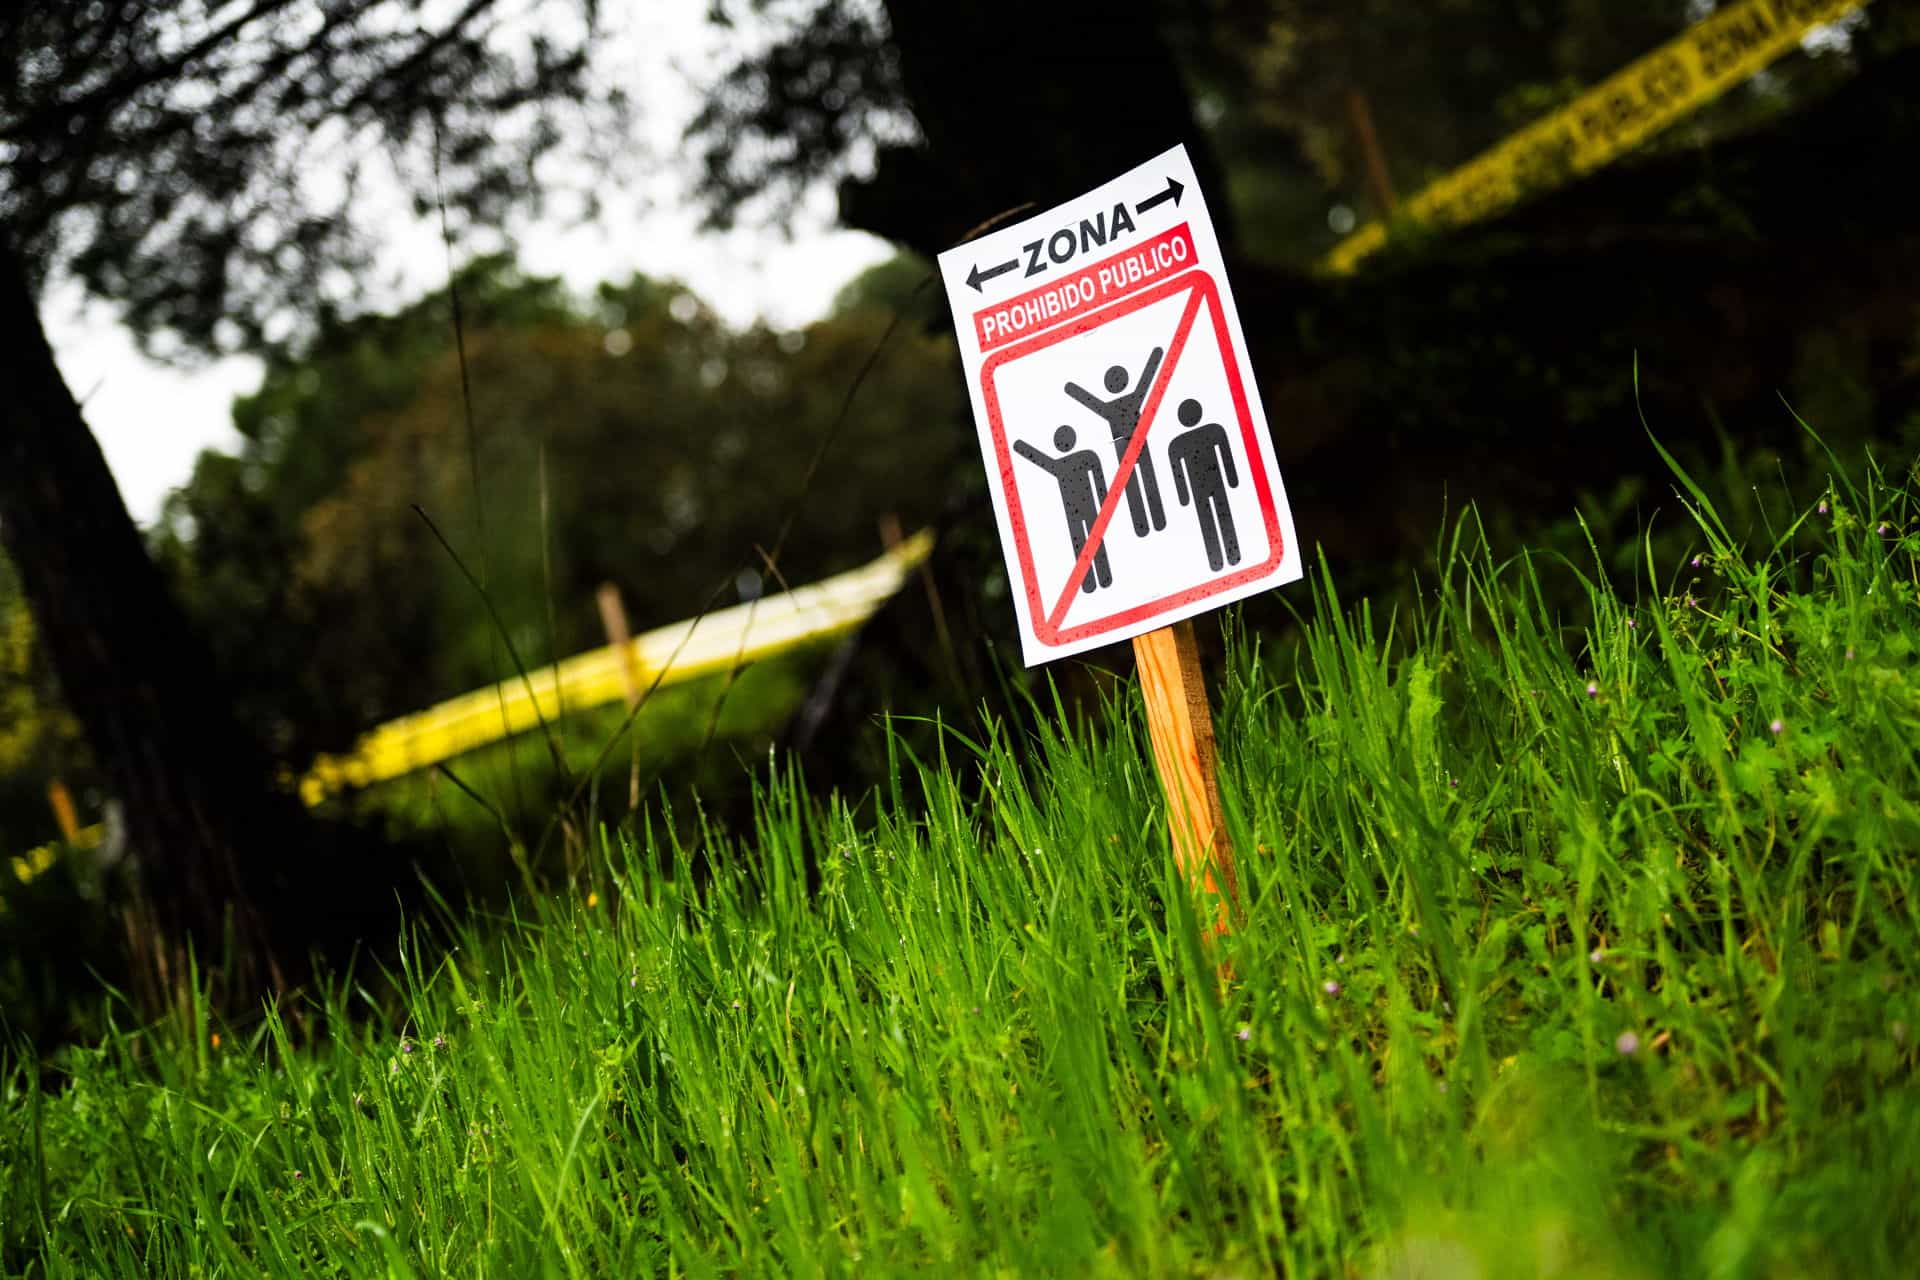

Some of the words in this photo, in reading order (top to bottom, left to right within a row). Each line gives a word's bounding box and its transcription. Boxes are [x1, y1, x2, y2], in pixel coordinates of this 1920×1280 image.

[1022, 202, 1136, 278] ZONA
[982, 277, 1095, 341] PROHIBIDO
[1099, 236, 1186, 294] PUBLICO
